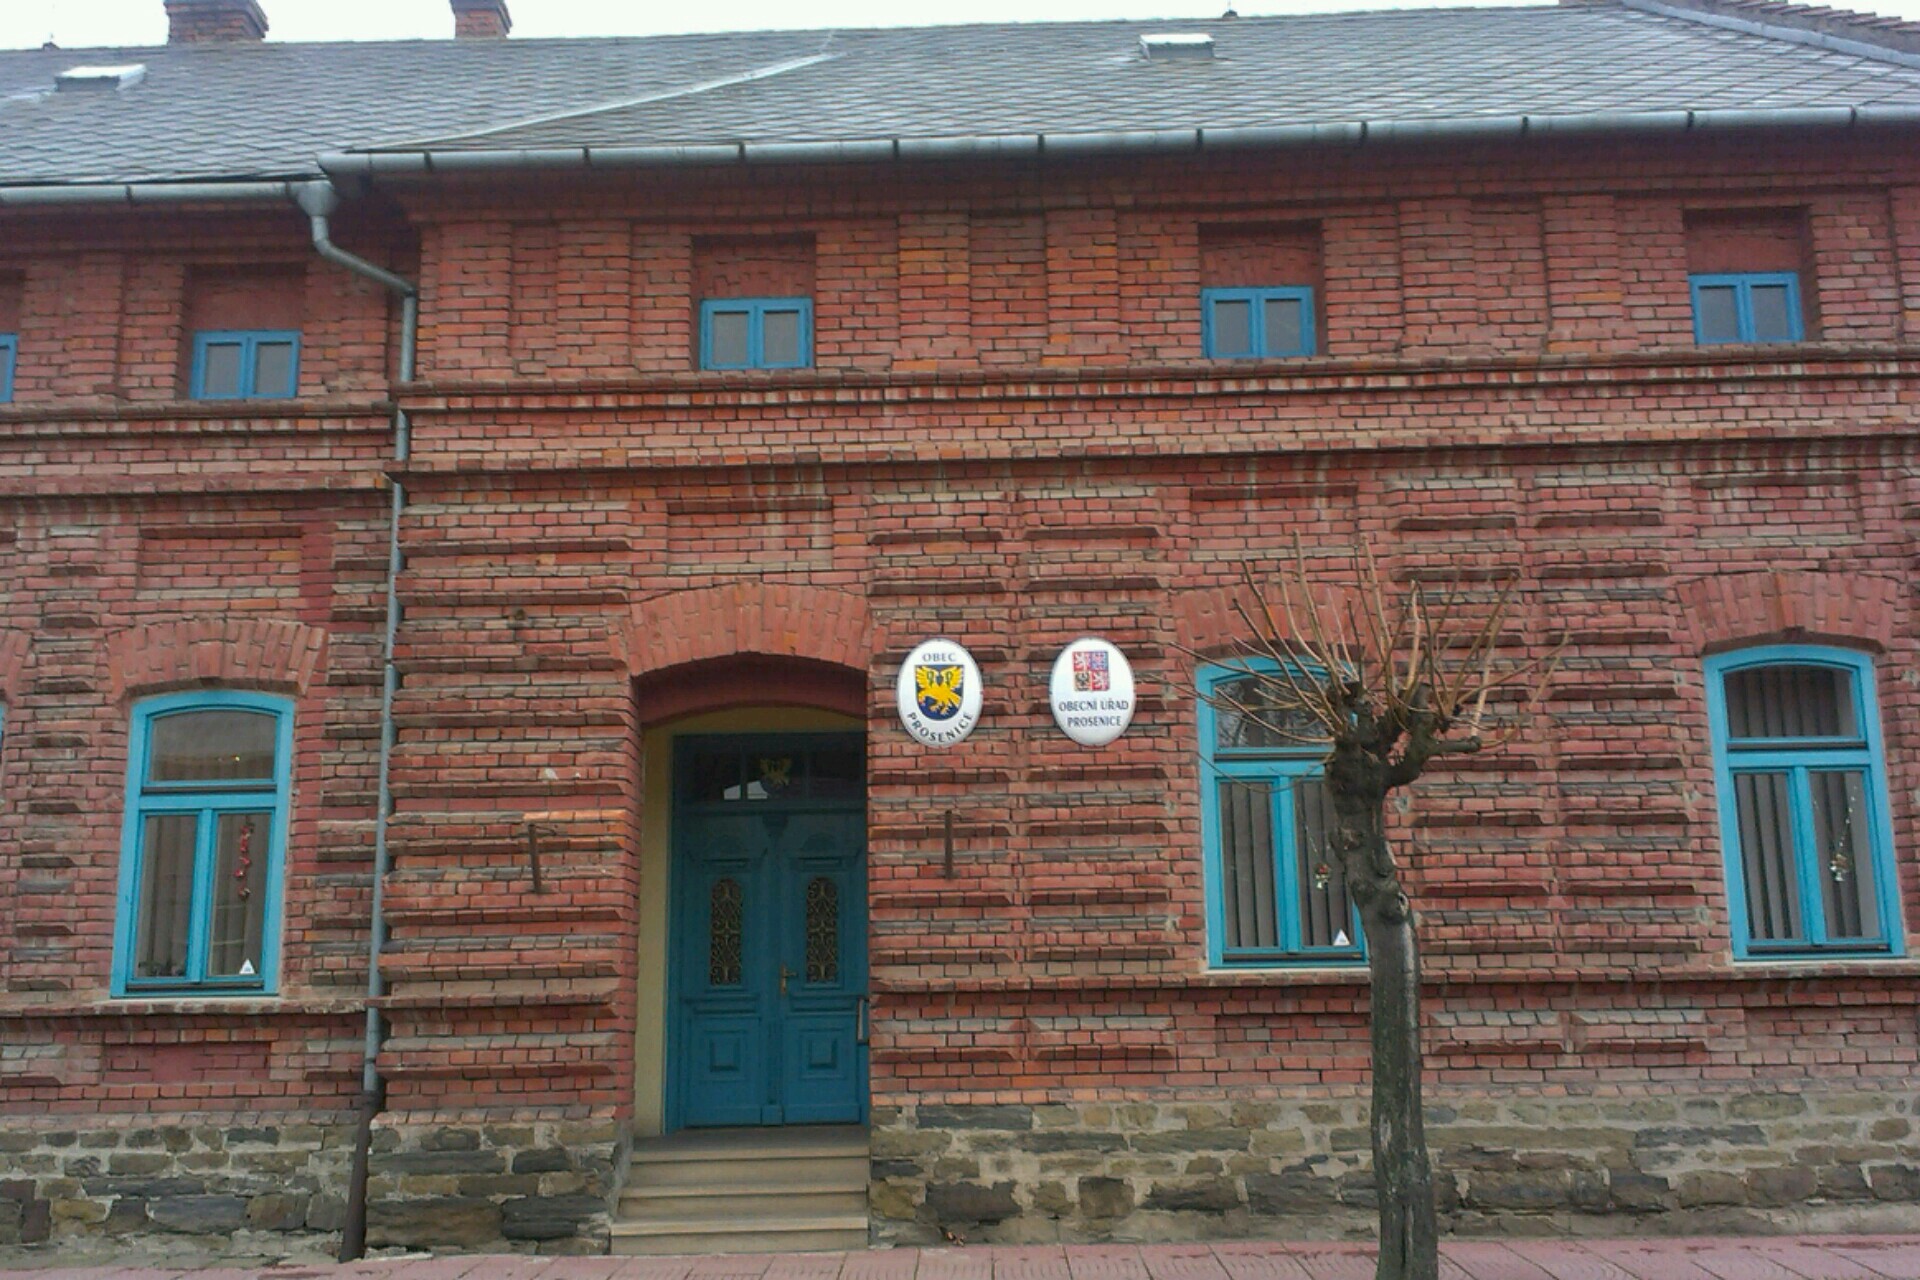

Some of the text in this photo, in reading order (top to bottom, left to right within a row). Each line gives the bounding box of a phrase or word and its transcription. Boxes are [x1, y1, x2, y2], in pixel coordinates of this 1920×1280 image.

[922, 652, 956, 662] OBEC
[1067, 714, 1121, 727] PROSENICE
[907, 712, 973, 743] PROSENICE
